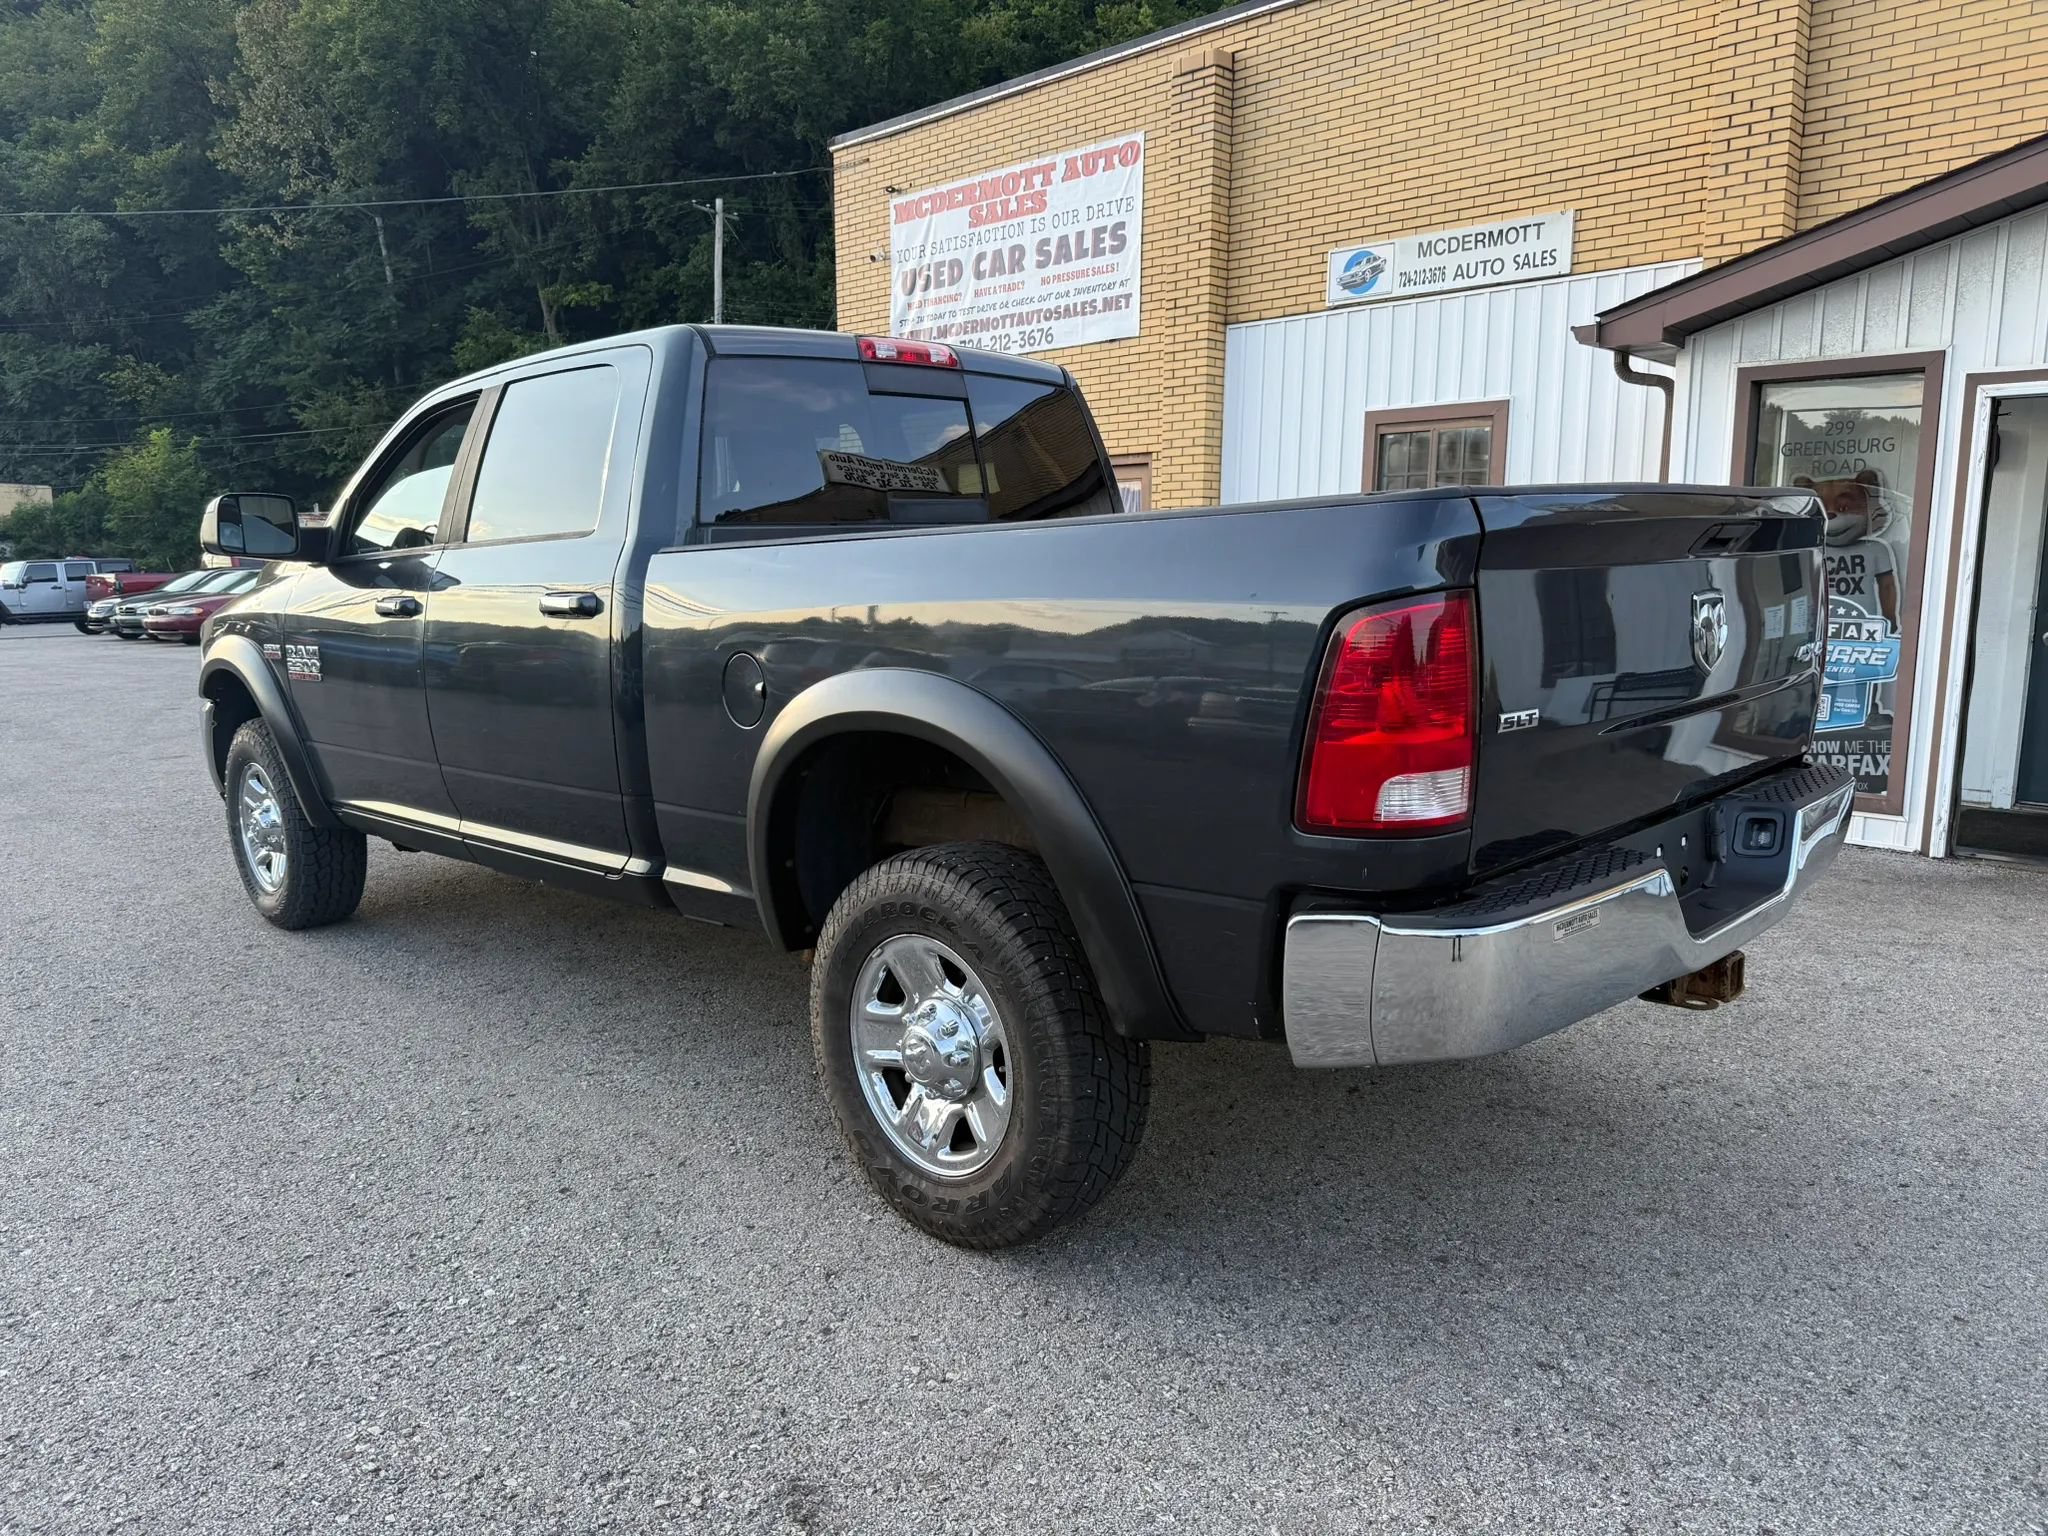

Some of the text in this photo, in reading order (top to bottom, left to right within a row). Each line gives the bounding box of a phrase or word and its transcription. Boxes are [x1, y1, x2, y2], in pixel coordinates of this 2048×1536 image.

[893, 140, 1141, 225] MCDERMOTT AUTO
[968, 189, 1048, 229] SALES
[895, 196, 1135, 264] YOUR SATISFACTION IS OUR DRIVE
[1417, 221, 1546, 258] MCDERMOTT
[901, 220, 1128, 296] USED CAR SALES
[1398, 248, 1557, 288] 724-212-3676 AUTO SALES
[974, 285, 991, 298] HAVE
[998, 279, 1025, 293] TRADE?
[1040, 275, 1051, 286] NO
[1052, 267, 1090, 284] PRESSURE
[1091, 262, 1120, 277] SALES!
[899, 293, 1133, 340] WW.MCDERMOTTAUTOSALES.NET
[926, 311, 947, 322] TODAY
[948, 310, 957, 318] TO
[959, 306, 977, 316] TEST
[976, 302, 998, 313] DRIVE
[999, 301, 1010, 309] OR
[1011, 297, 1035, 307] CHECK
[1037, 293, 1054, 303] OUT
[1055, 290, 1071, 300] OUR
[1073, 281, 1117, 297] INVENTORY
[1118, 278, 1131, 289] AT
[1824, 420, 1855, 437] 299
[1781, 437, 1895, 457] GREENSBURG
[1812, 458, 1867, 474] ROAD
[1827, 554, 1865, 576] CAR
[1827, 622, 1878, 640] FAX
[285, 644, 319, 659] RAM
[1500, 711, 1538, 731] SLT
[1807, 740, 1892, 754] HOW ME THE
